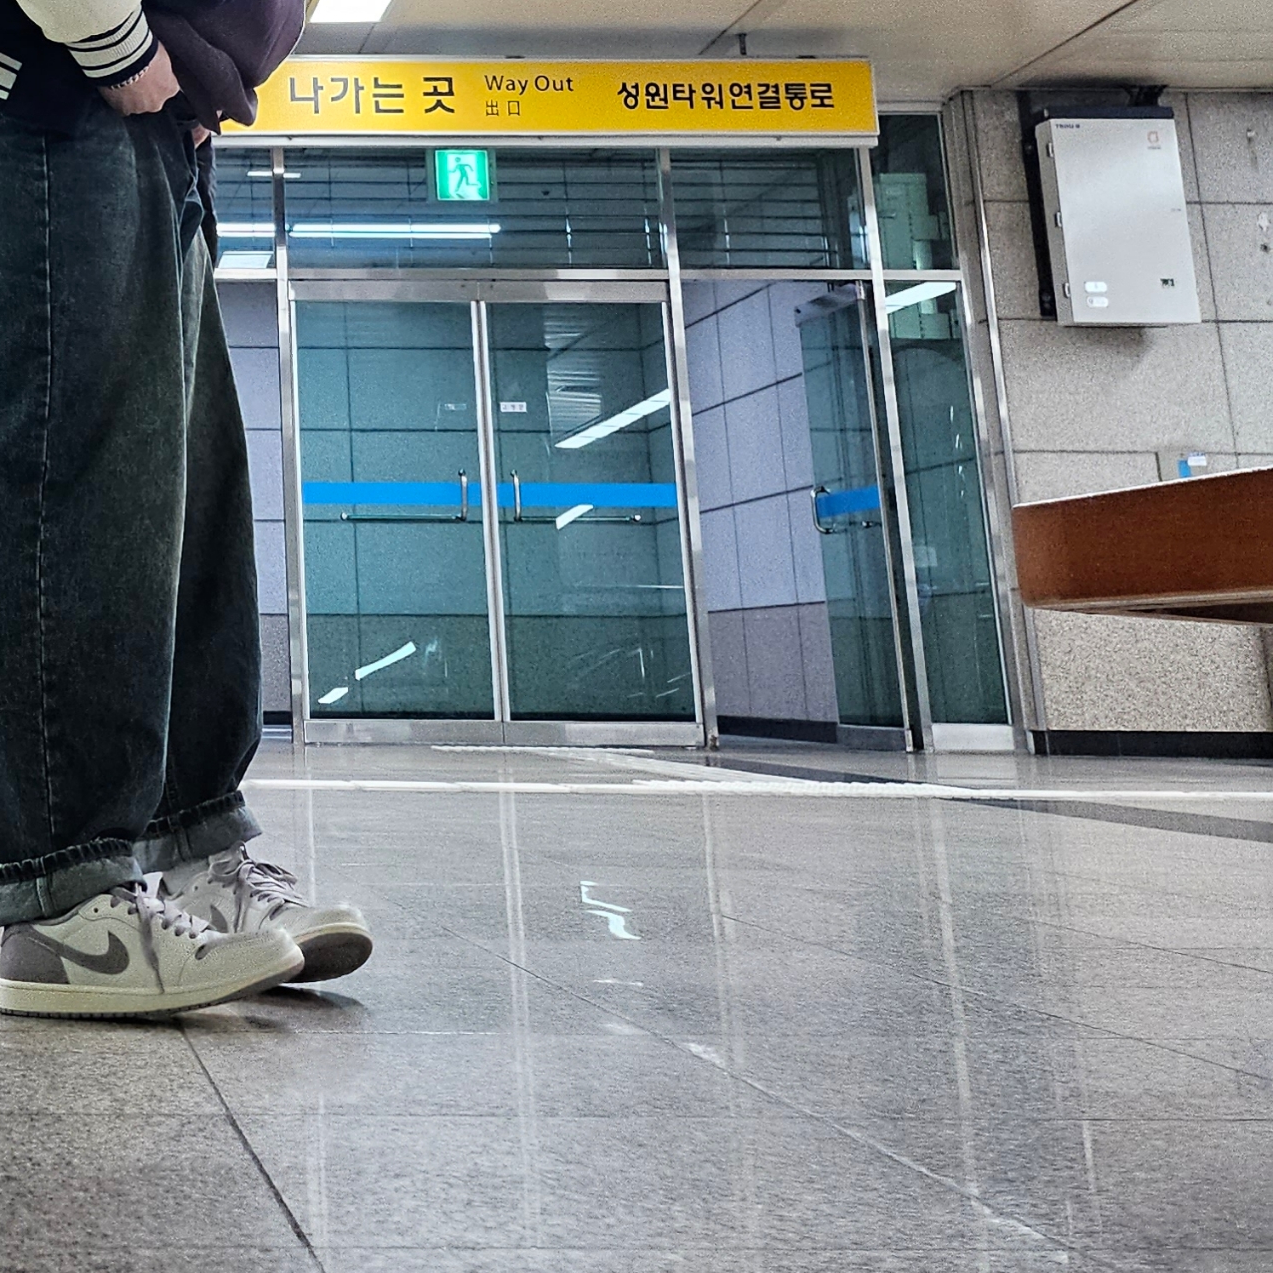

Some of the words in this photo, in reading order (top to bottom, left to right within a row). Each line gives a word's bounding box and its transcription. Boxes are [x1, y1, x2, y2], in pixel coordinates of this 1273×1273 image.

[289, 76, 404, 115] 나가는
[422, 76, 455, 114] 곳
[484, 74, 528, 96] Way
[534, 74, 574, 92] Out
[617, 81, 835, 111] 성원타워연결통로
[485, 99, 521, 116] 出口
